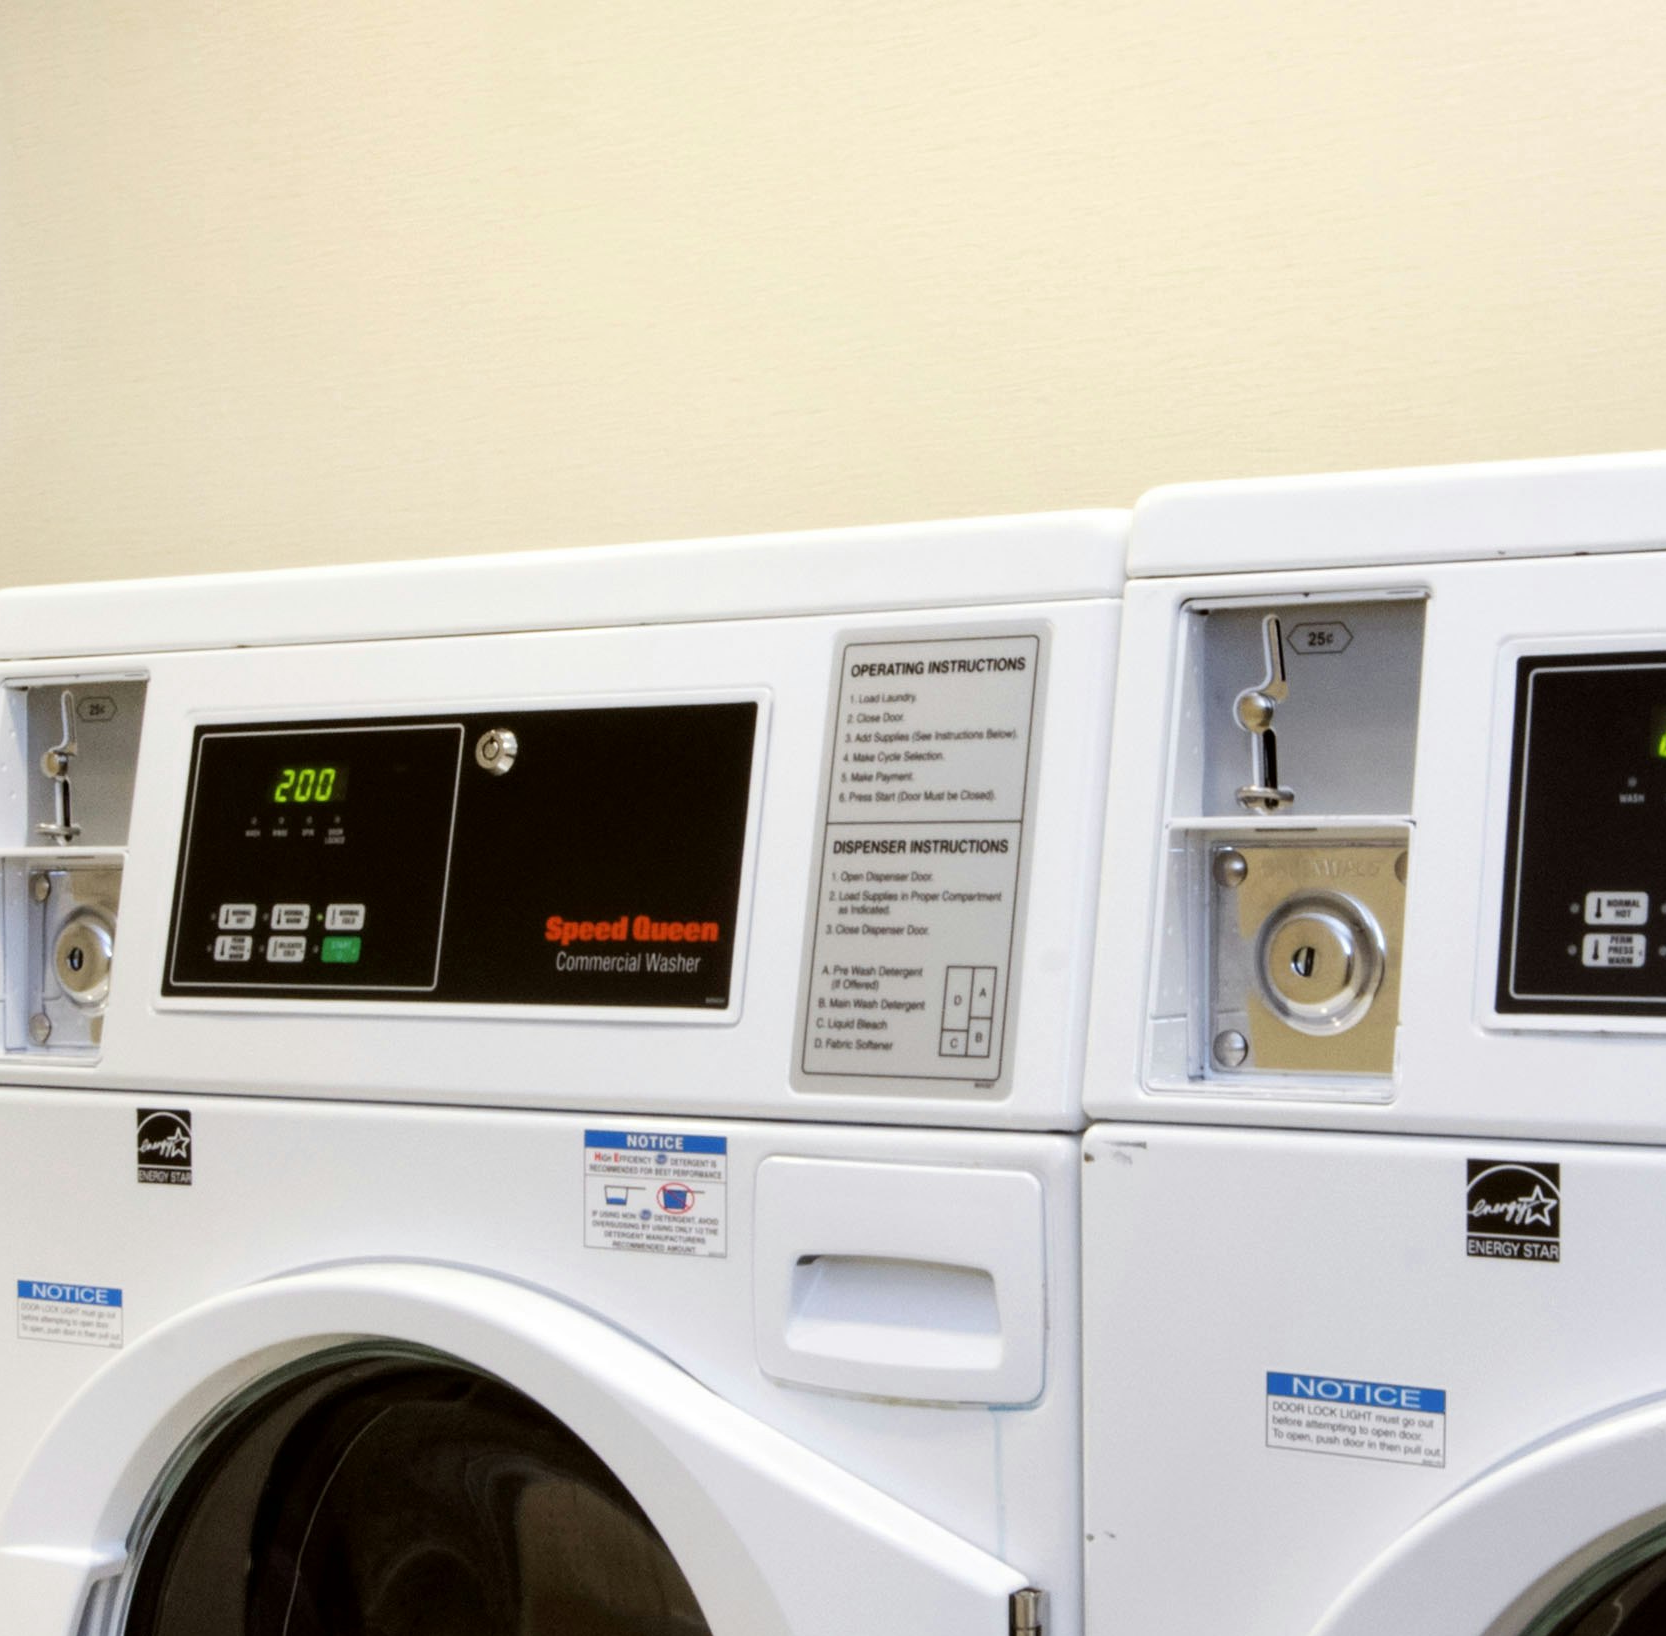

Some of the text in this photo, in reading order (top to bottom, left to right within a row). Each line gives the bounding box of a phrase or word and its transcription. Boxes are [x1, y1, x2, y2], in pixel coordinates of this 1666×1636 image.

[851, 657, 1026, 677] OPERATING INSTRUCTIONS
[274, 768, 336, 803] 200
[833, 840, 1009, 854] DISPENSER INSTRUCTIONS
[545, 916, 719, 947] Speed Queen
[556, 952, 700, 973] Commercial Washer
[627, 1135, 683, 1149] NOTICE
[138, 1170, 191, 1183] ENERGY STAR
[1468, 1239, 1559, 1260] ENERGY STAR
[33, 1284, 108, 1304] NOTICE
[1293, 1377, 1421, 1408] NOTICE
